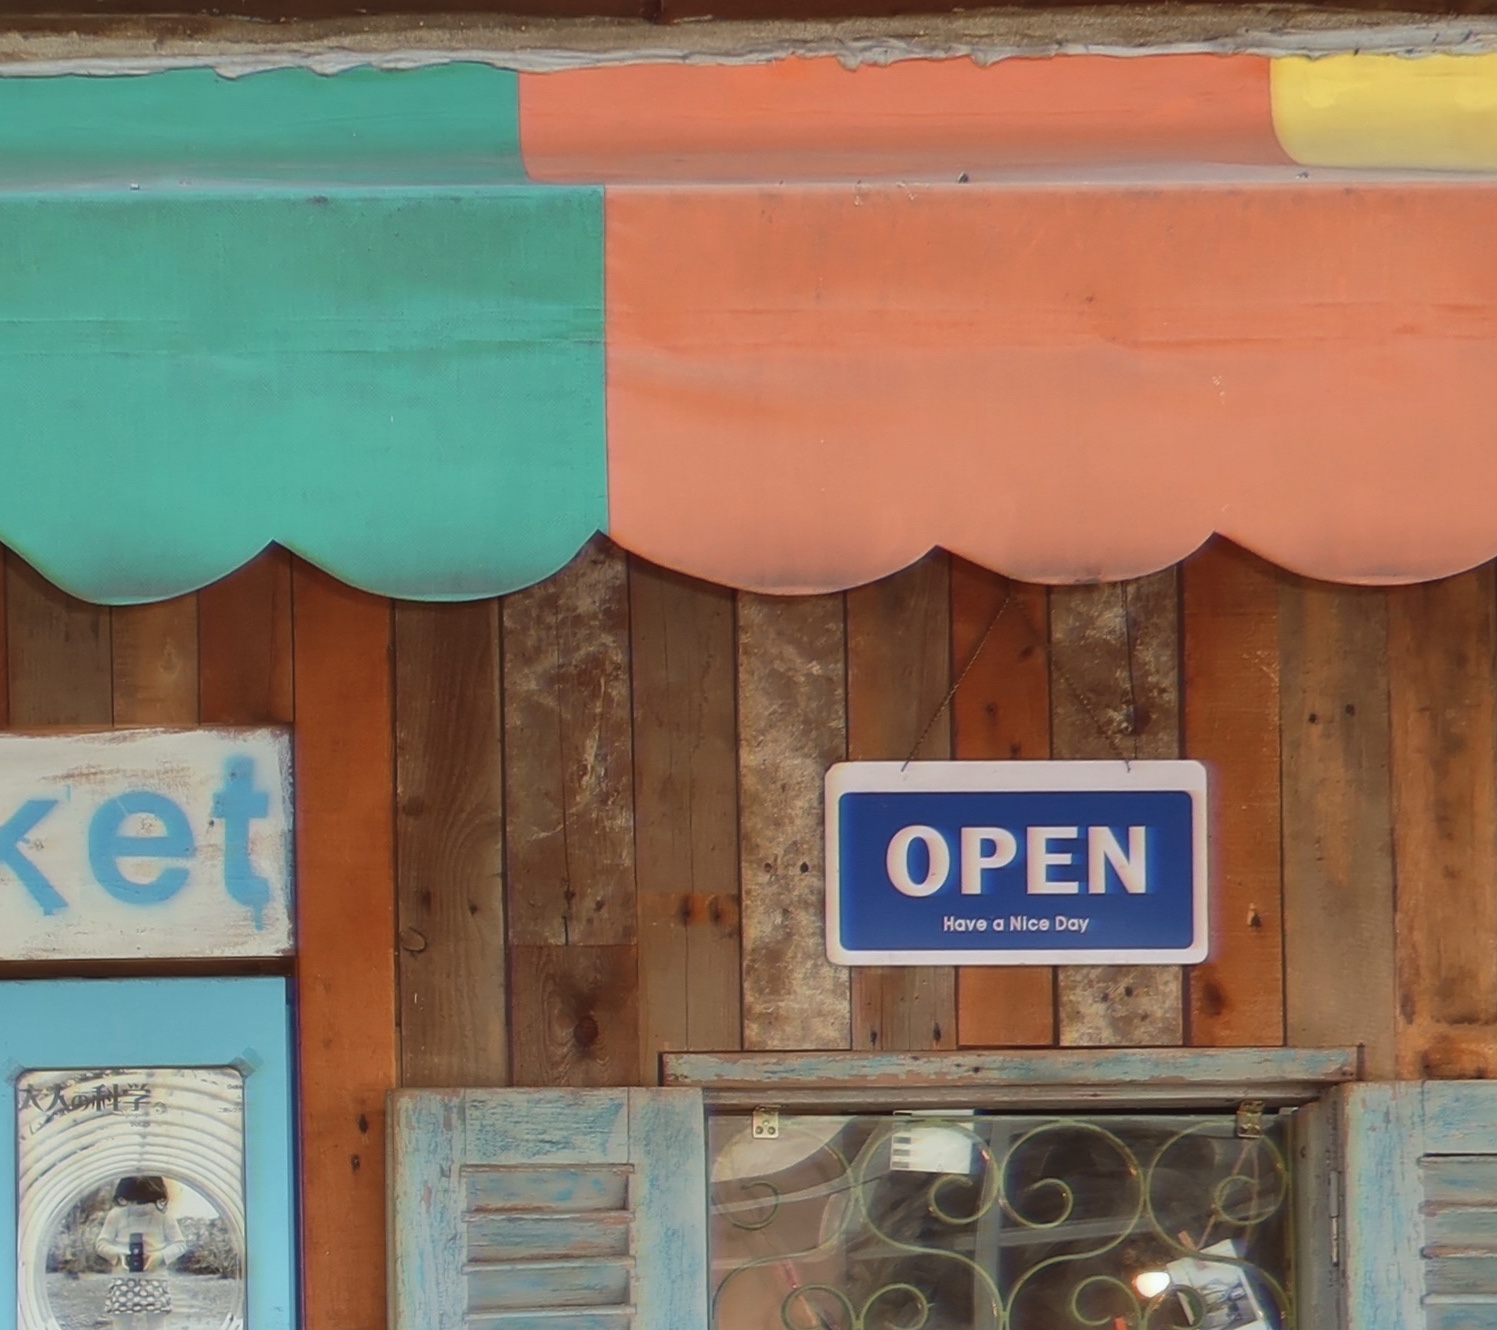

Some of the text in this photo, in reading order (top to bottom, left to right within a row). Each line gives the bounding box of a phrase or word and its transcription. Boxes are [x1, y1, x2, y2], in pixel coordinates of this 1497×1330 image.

[886, 824, 1147, 898] OPEN
[943, 915, 1090, 934] Have a Nice Day
[18, 1083, 152, 1112] 大人の科学
